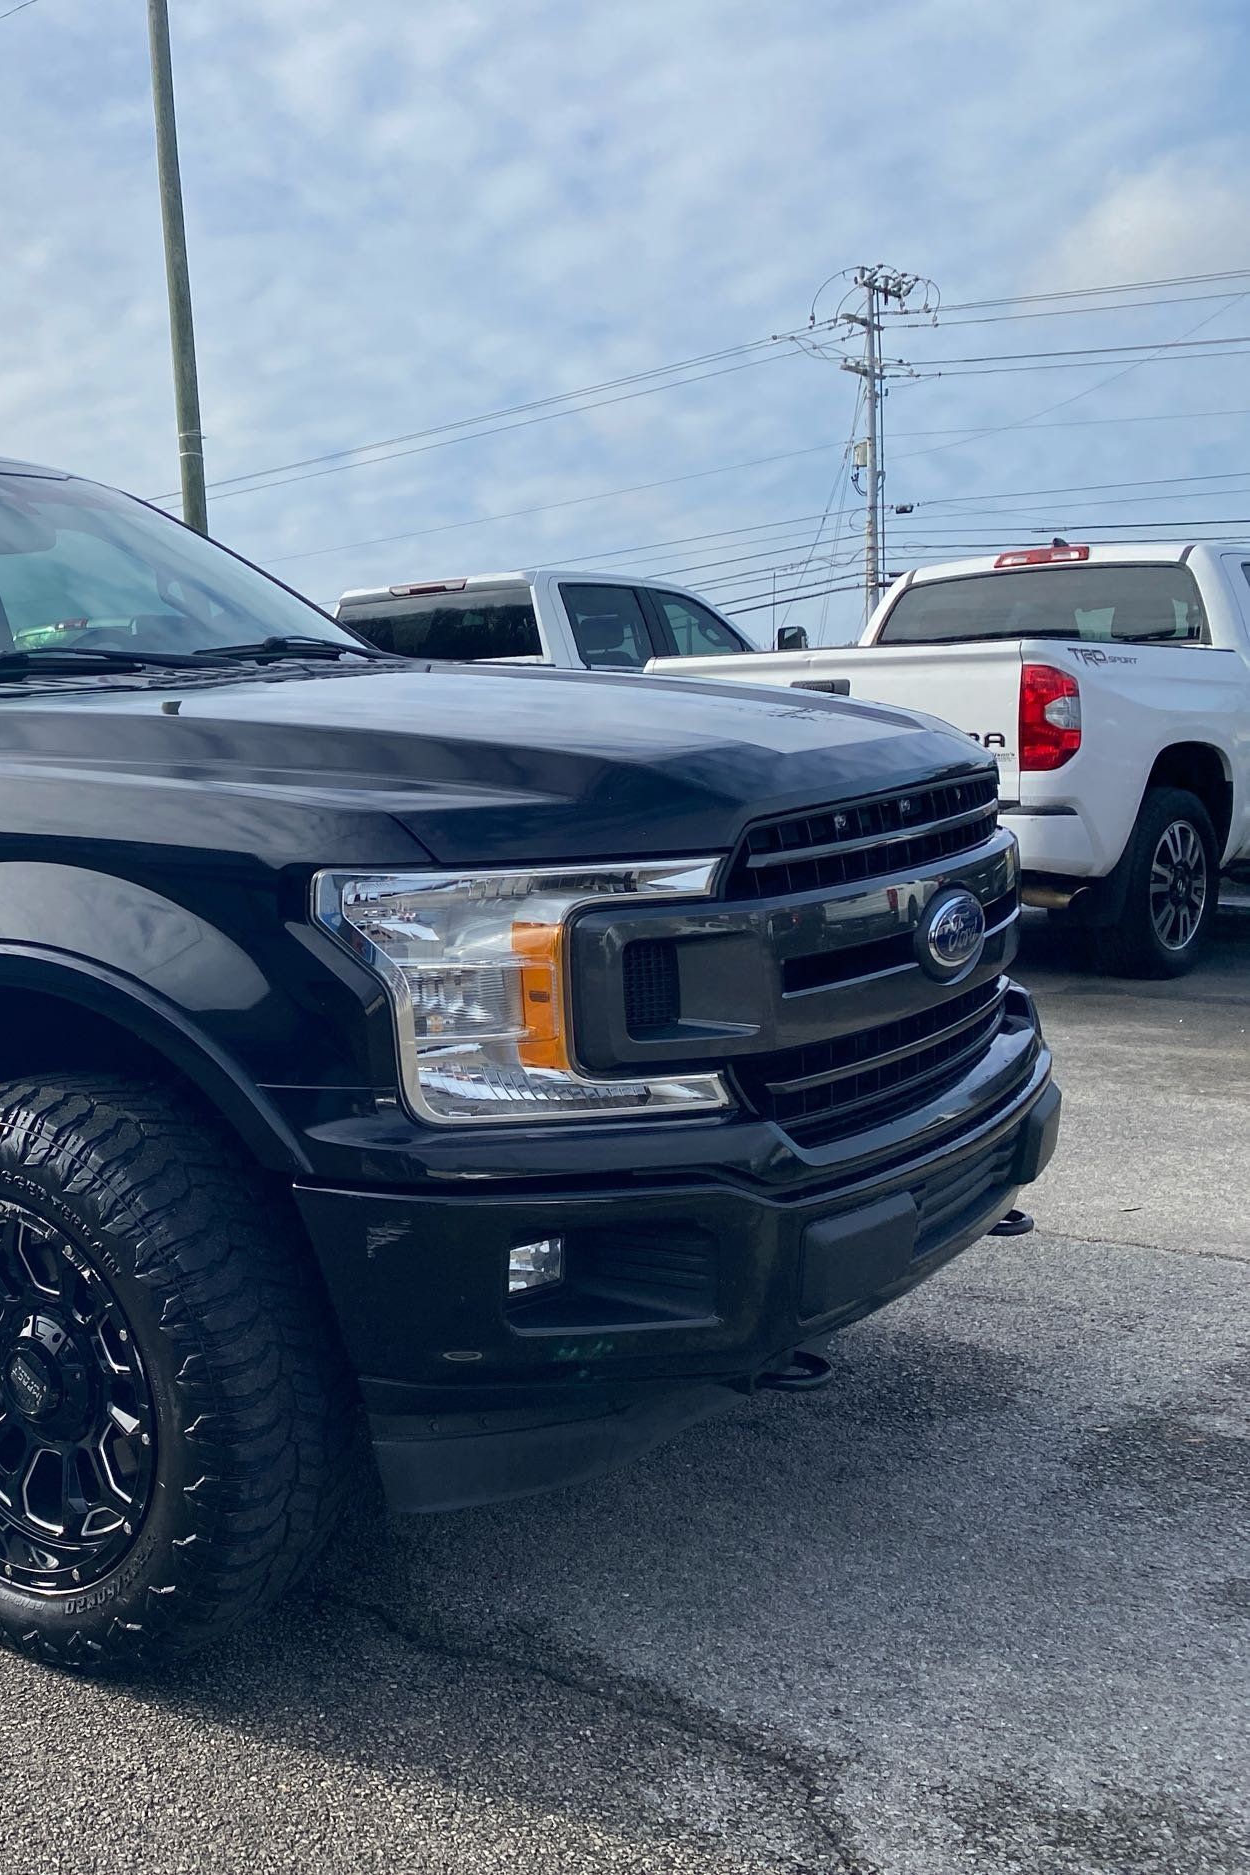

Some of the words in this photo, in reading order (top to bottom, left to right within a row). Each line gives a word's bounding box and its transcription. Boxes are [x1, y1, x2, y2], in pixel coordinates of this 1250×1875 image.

[1067, 647, 1107, 667] TRD
[1108, 655, 1139, 665] SPORT
[937, 910, 978, 953] Ford
